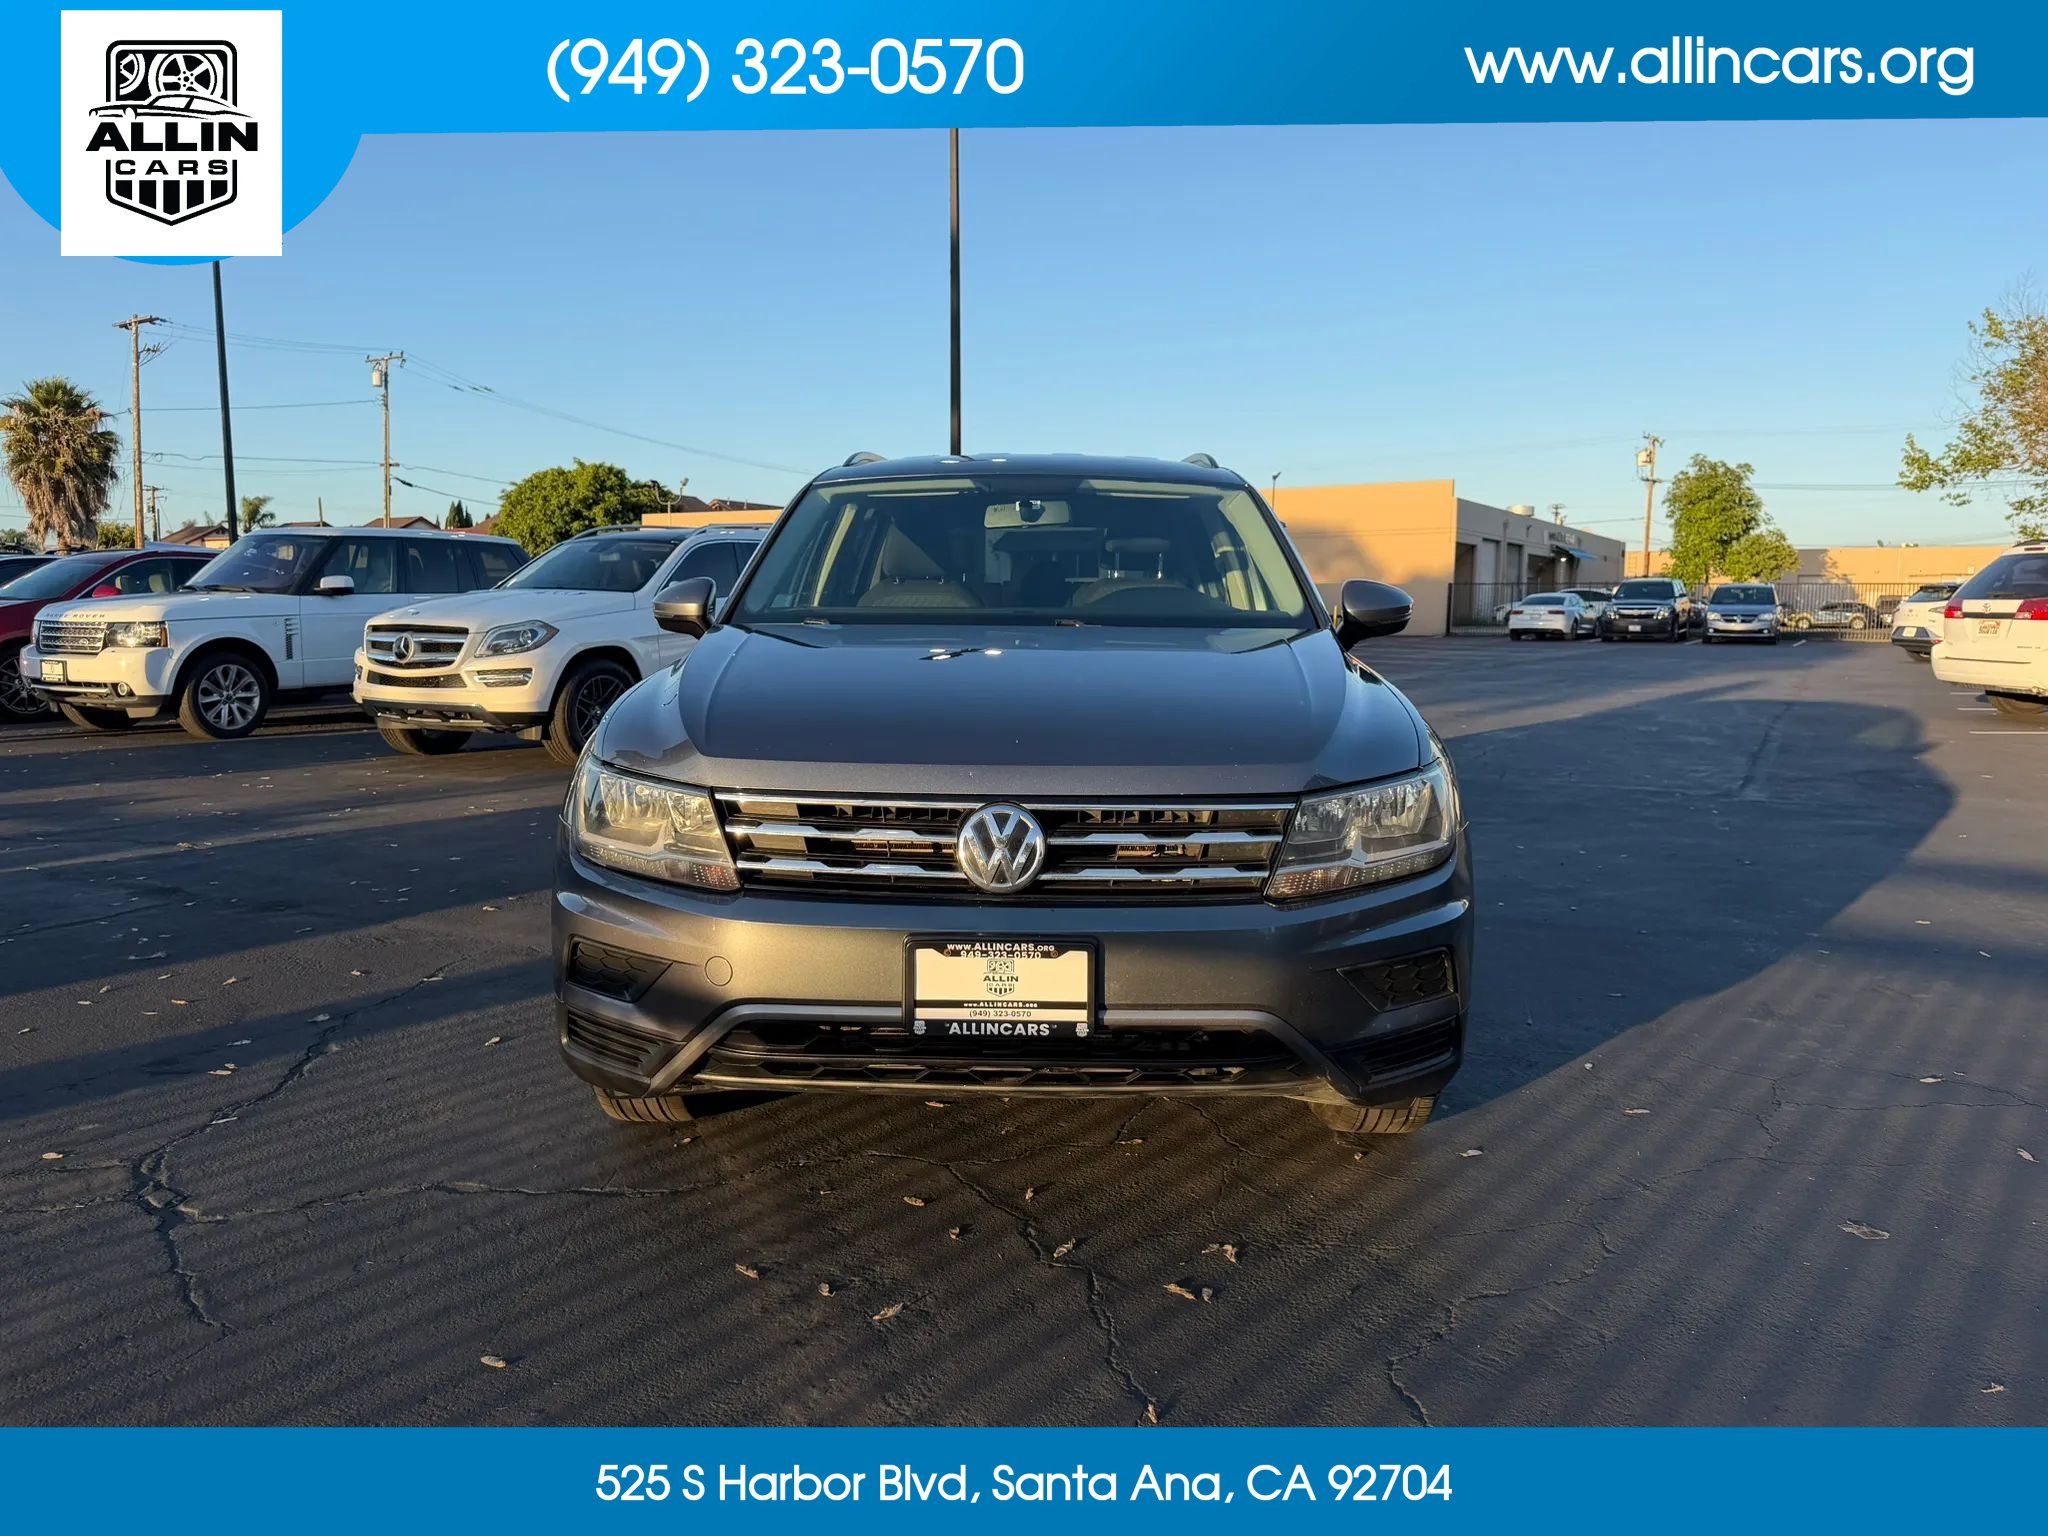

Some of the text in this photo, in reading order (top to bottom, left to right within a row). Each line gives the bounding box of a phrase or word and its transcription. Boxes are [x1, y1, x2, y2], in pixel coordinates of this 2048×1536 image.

[960, 950, 1042, 959] 949-323-0570
[969, 1010, 1032, 1018] (949) 323-0570
